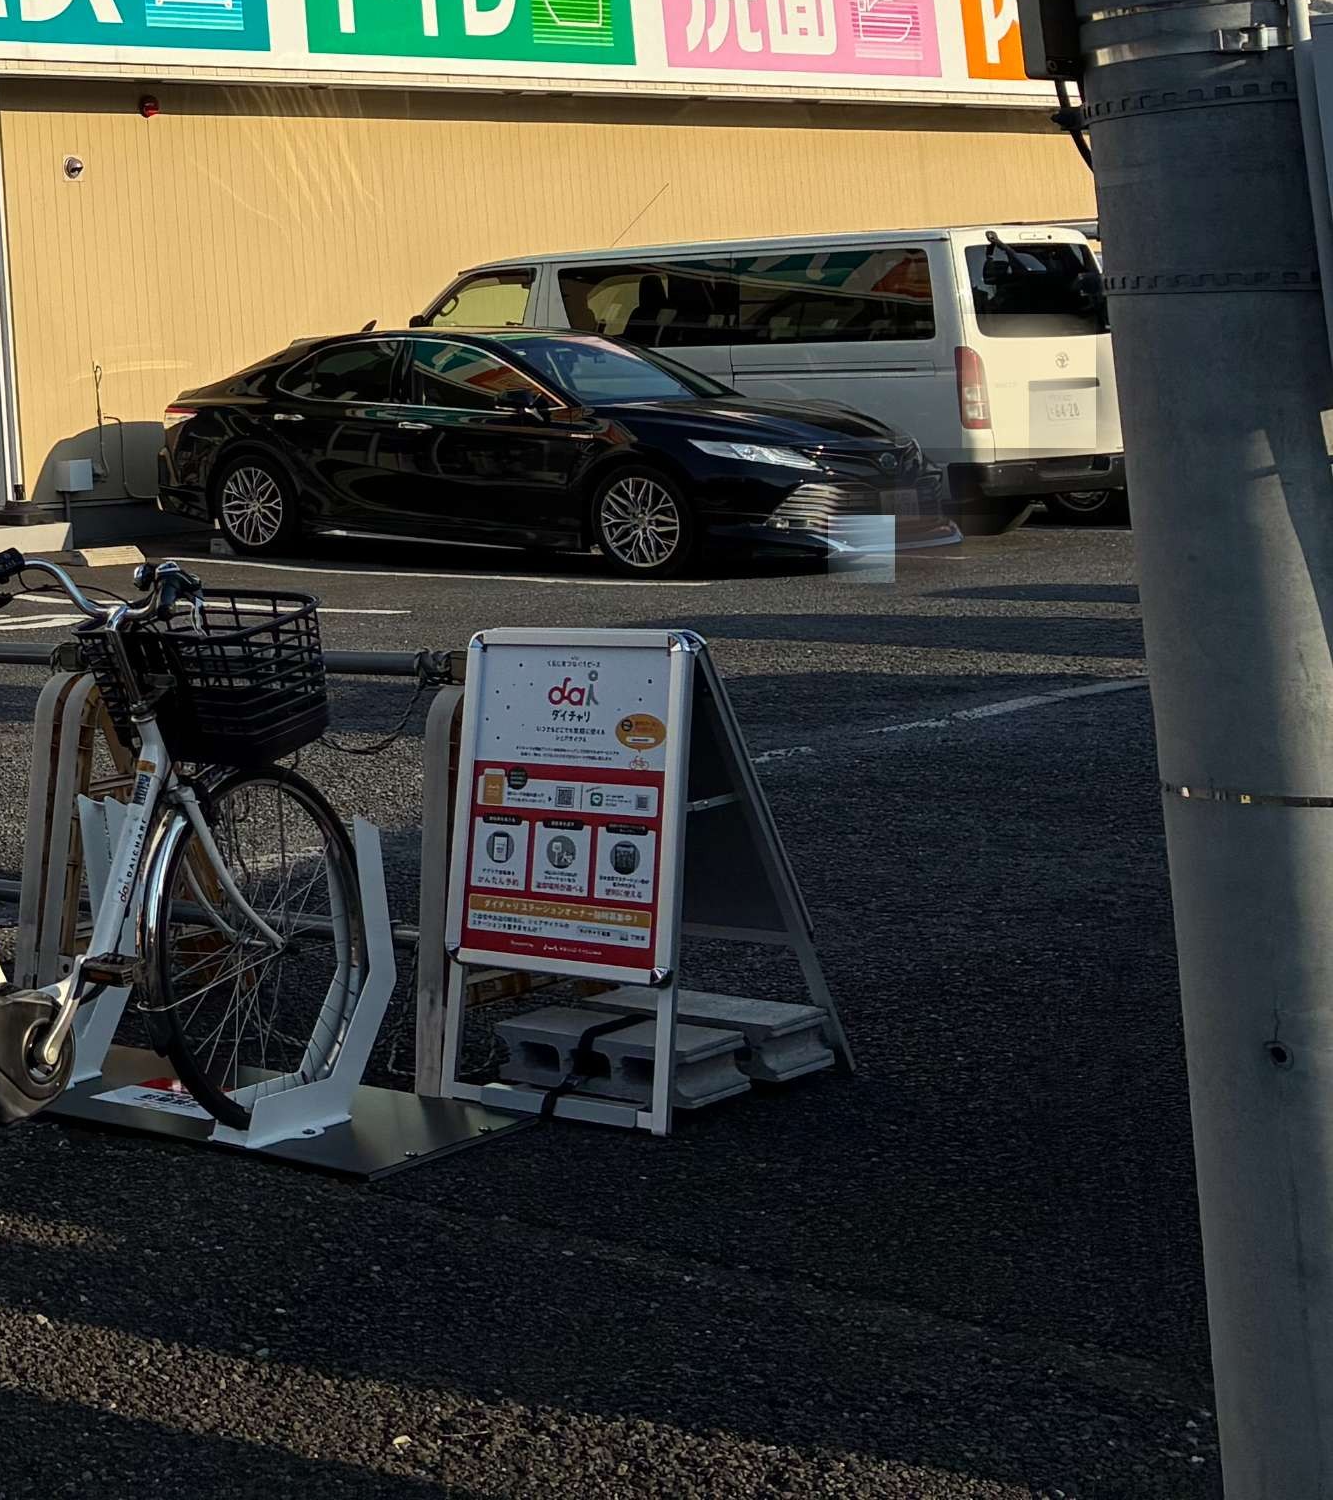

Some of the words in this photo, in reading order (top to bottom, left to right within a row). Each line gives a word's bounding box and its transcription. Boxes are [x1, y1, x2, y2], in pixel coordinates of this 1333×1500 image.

[551, 708, 591, 723] ダイチャリ
